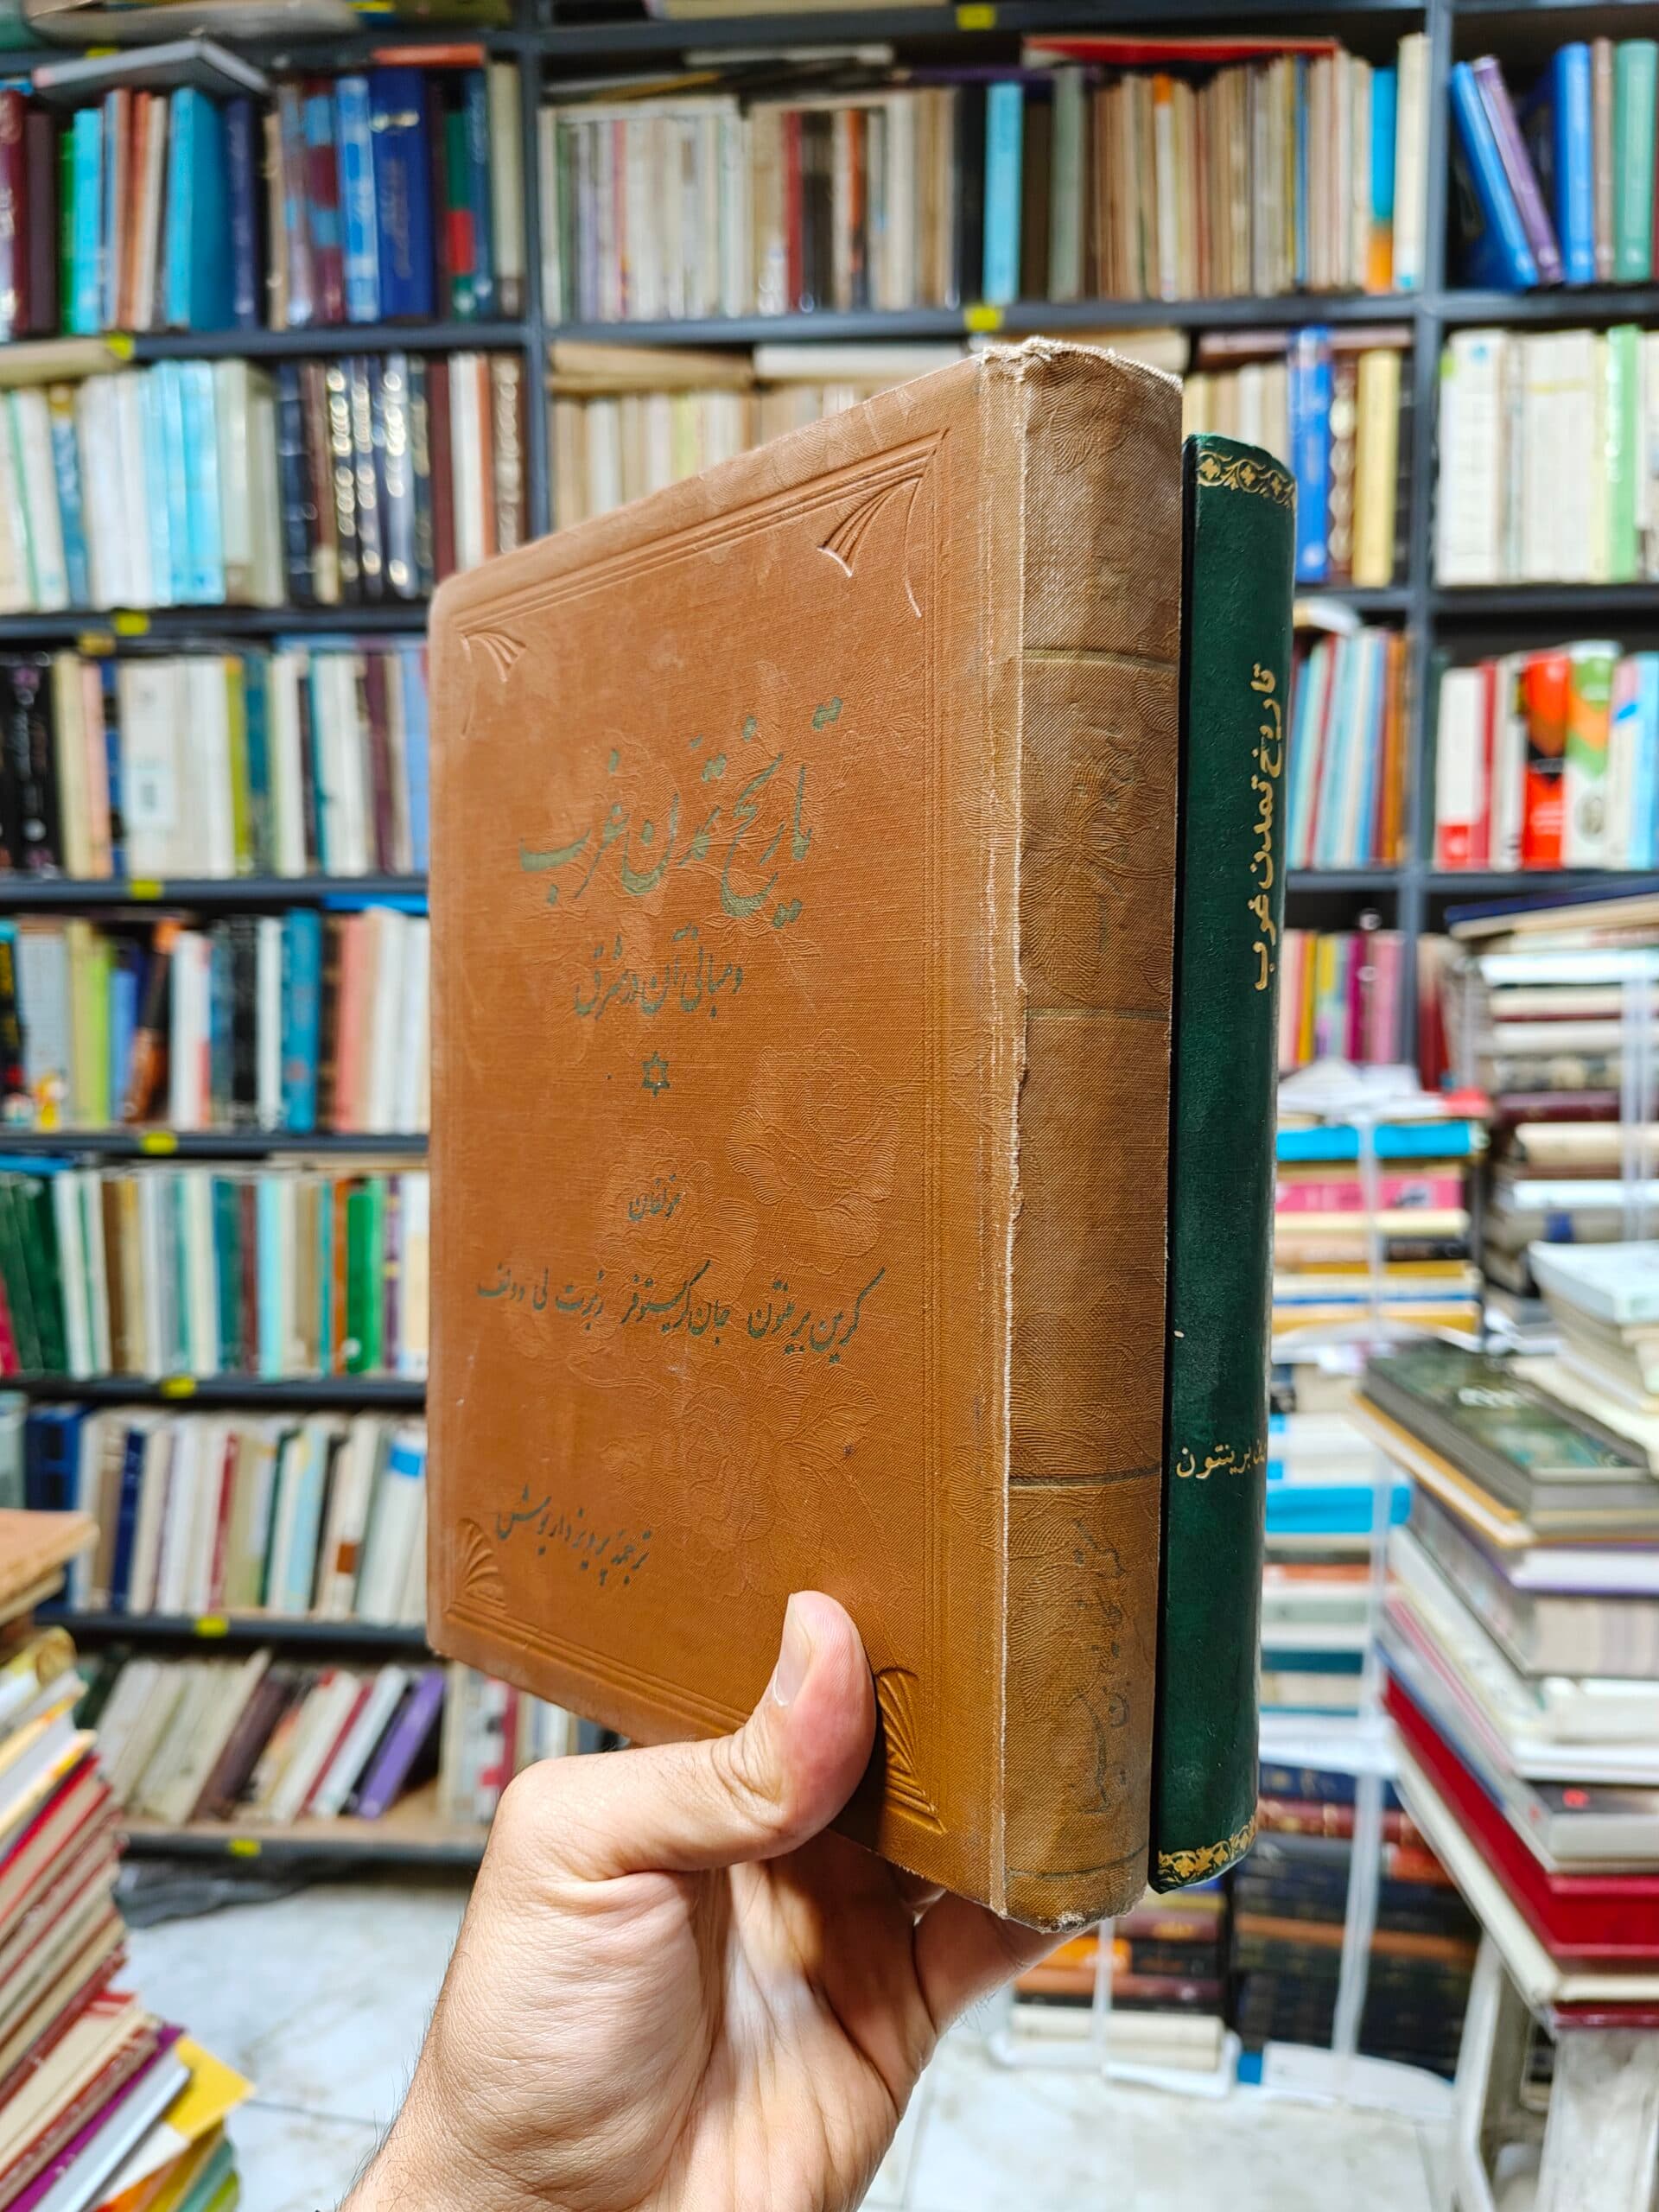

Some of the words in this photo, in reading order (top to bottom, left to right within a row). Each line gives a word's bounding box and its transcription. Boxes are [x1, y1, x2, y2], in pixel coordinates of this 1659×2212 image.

[1250, 663, 1282, 779] تاریخ
[519, 748, 629, 906] غرب
[621, 750, 728, 897] تمدن
[721, 696, 843, 930] تاریخ
[1249, 775, 1274, 890] تمدن
[574, 933, 630, 1021] شرق
[1248, 894, 1277, 991] غرب
[531, 1266, 549, 1312] لی
[555, 1268, 605, 1332] رابرت
[620, 1259, 712, 1333] کریستوفر
[688, 1299, 731, 1346] جان
[747, 1280, 810, 1355] برینتون
[809, 1267, 886, 1364] کرین
[1176, 1444, 1251, 1479] برینتون
